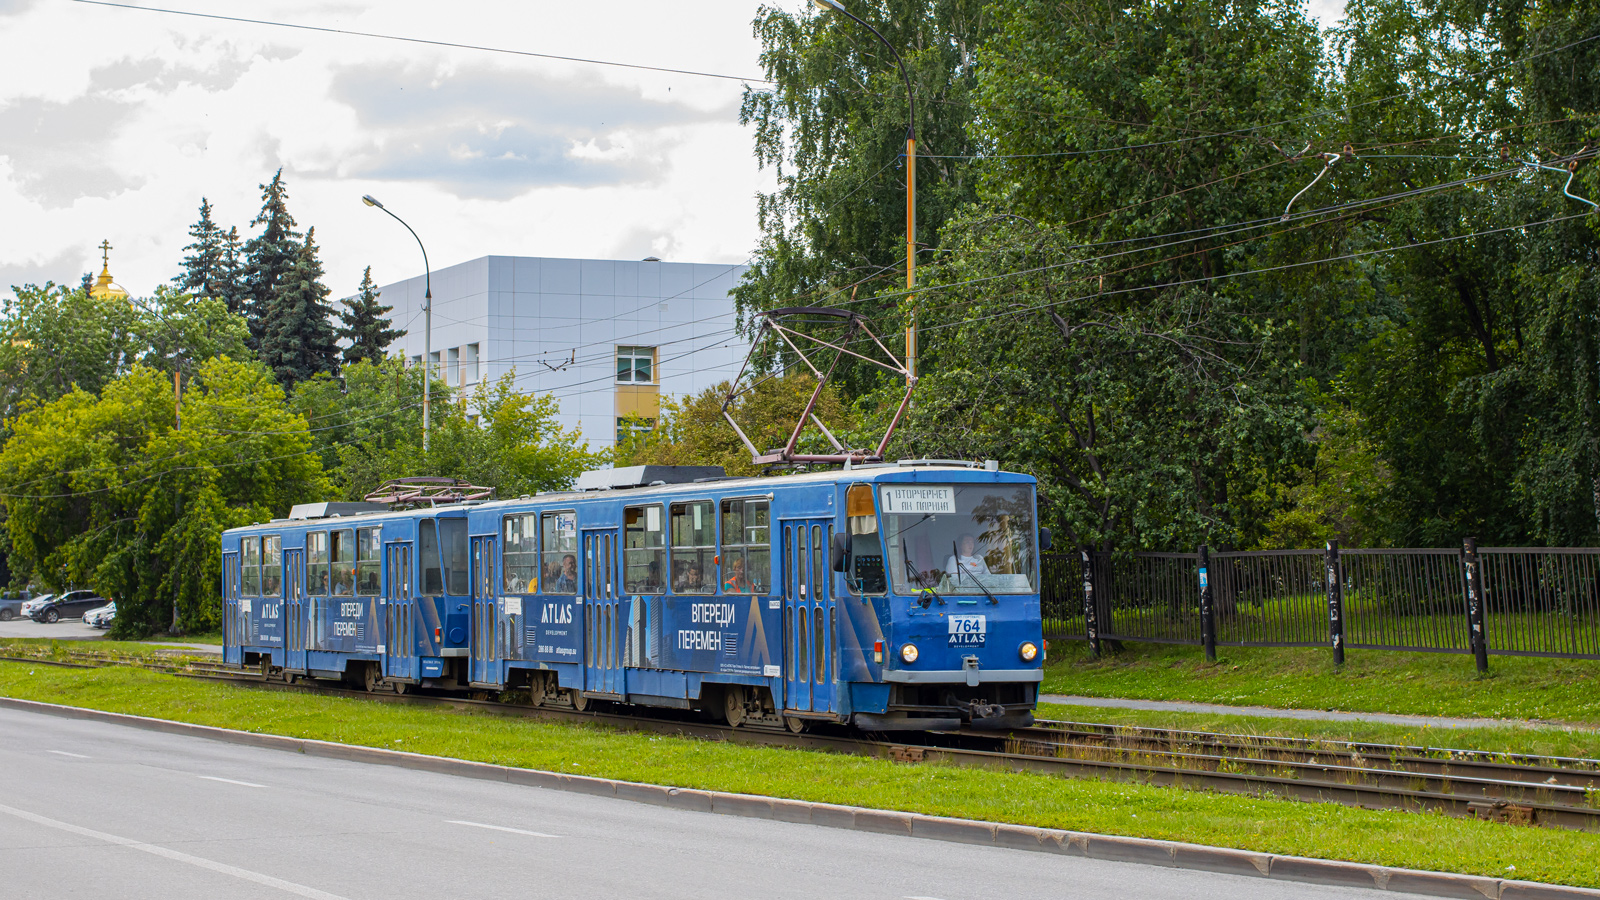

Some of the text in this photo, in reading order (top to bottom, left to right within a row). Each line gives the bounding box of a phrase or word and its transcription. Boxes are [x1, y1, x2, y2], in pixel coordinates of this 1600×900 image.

[885, 491, 892, 511] 1
[261, 603, 279, 619] ATLAS
[340, 602, 364, 620] ВПЕРЕДИ
[541, 603, 573, 624] ATLAS
[691, 603, 735, 628] ВПЕРЕДИ
[333, 621, 357, 637] ПЕРЕМЕН
[954, 619, 981, 633] 764
[678, 629, 722, 651] ПЕРЕМЕН
[948, 633, 986, 643] ATLAS
